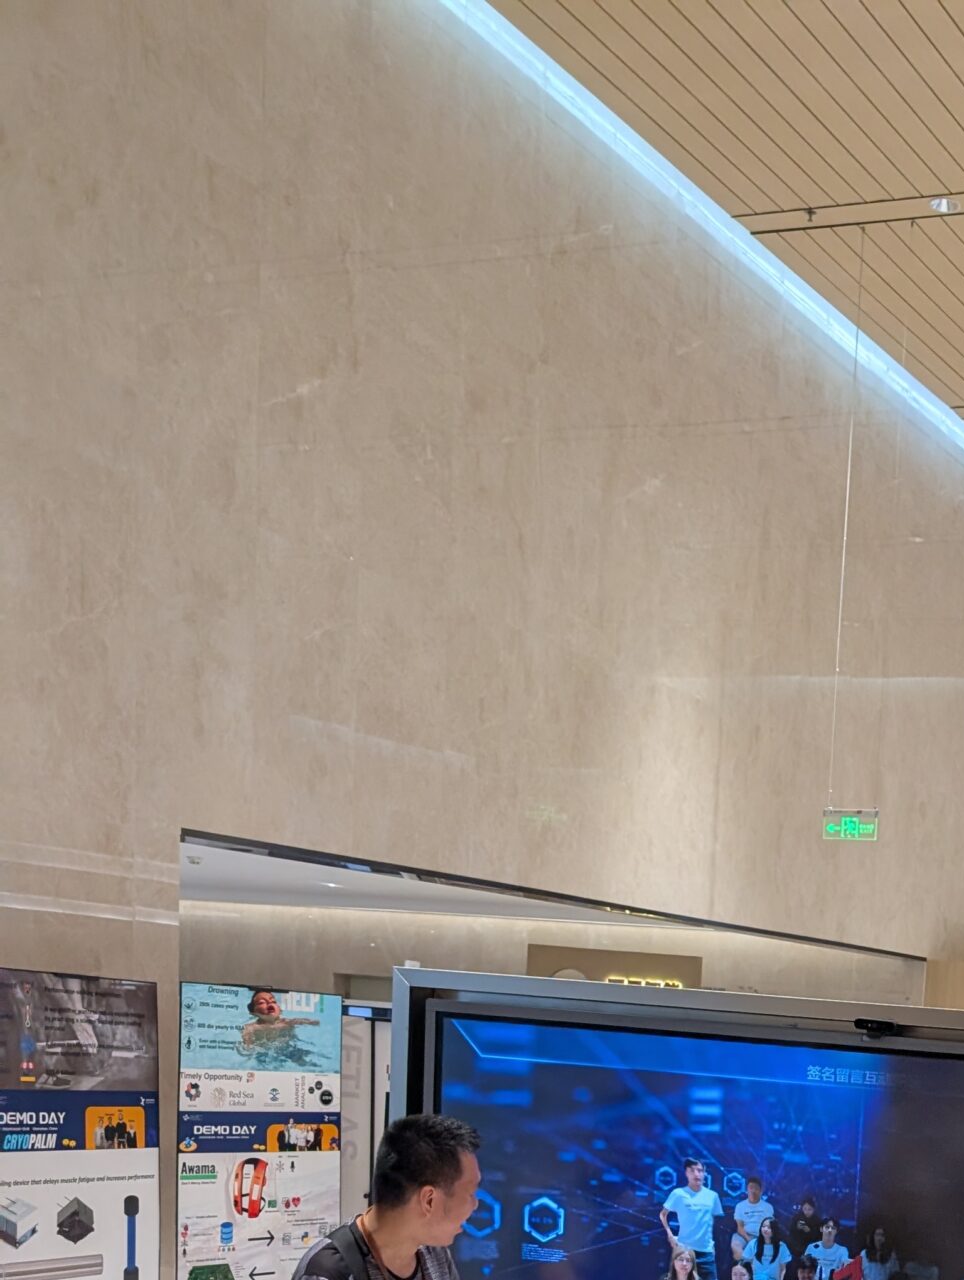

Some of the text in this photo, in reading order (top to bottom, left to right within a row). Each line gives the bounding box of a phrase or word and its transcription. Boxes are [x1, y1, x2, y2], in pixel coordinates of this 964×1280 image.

[207, 985, 239, 997] Drowning
[180, 1071, 243, 1082] Timely Opportunity
[228, 1090, 254, 1099] Red Sea
[0, 1112, 66, 1125] DEMO DAY
[193, 1125, 257, 1135] DEMO DAY
[3, 1133, 57, 1149] CRYOPALM
[181, 1162, 216, 1175] Awama
[78, 1176, 95, 1184] fatigue
[128, 1174, 155, 1182] performance
